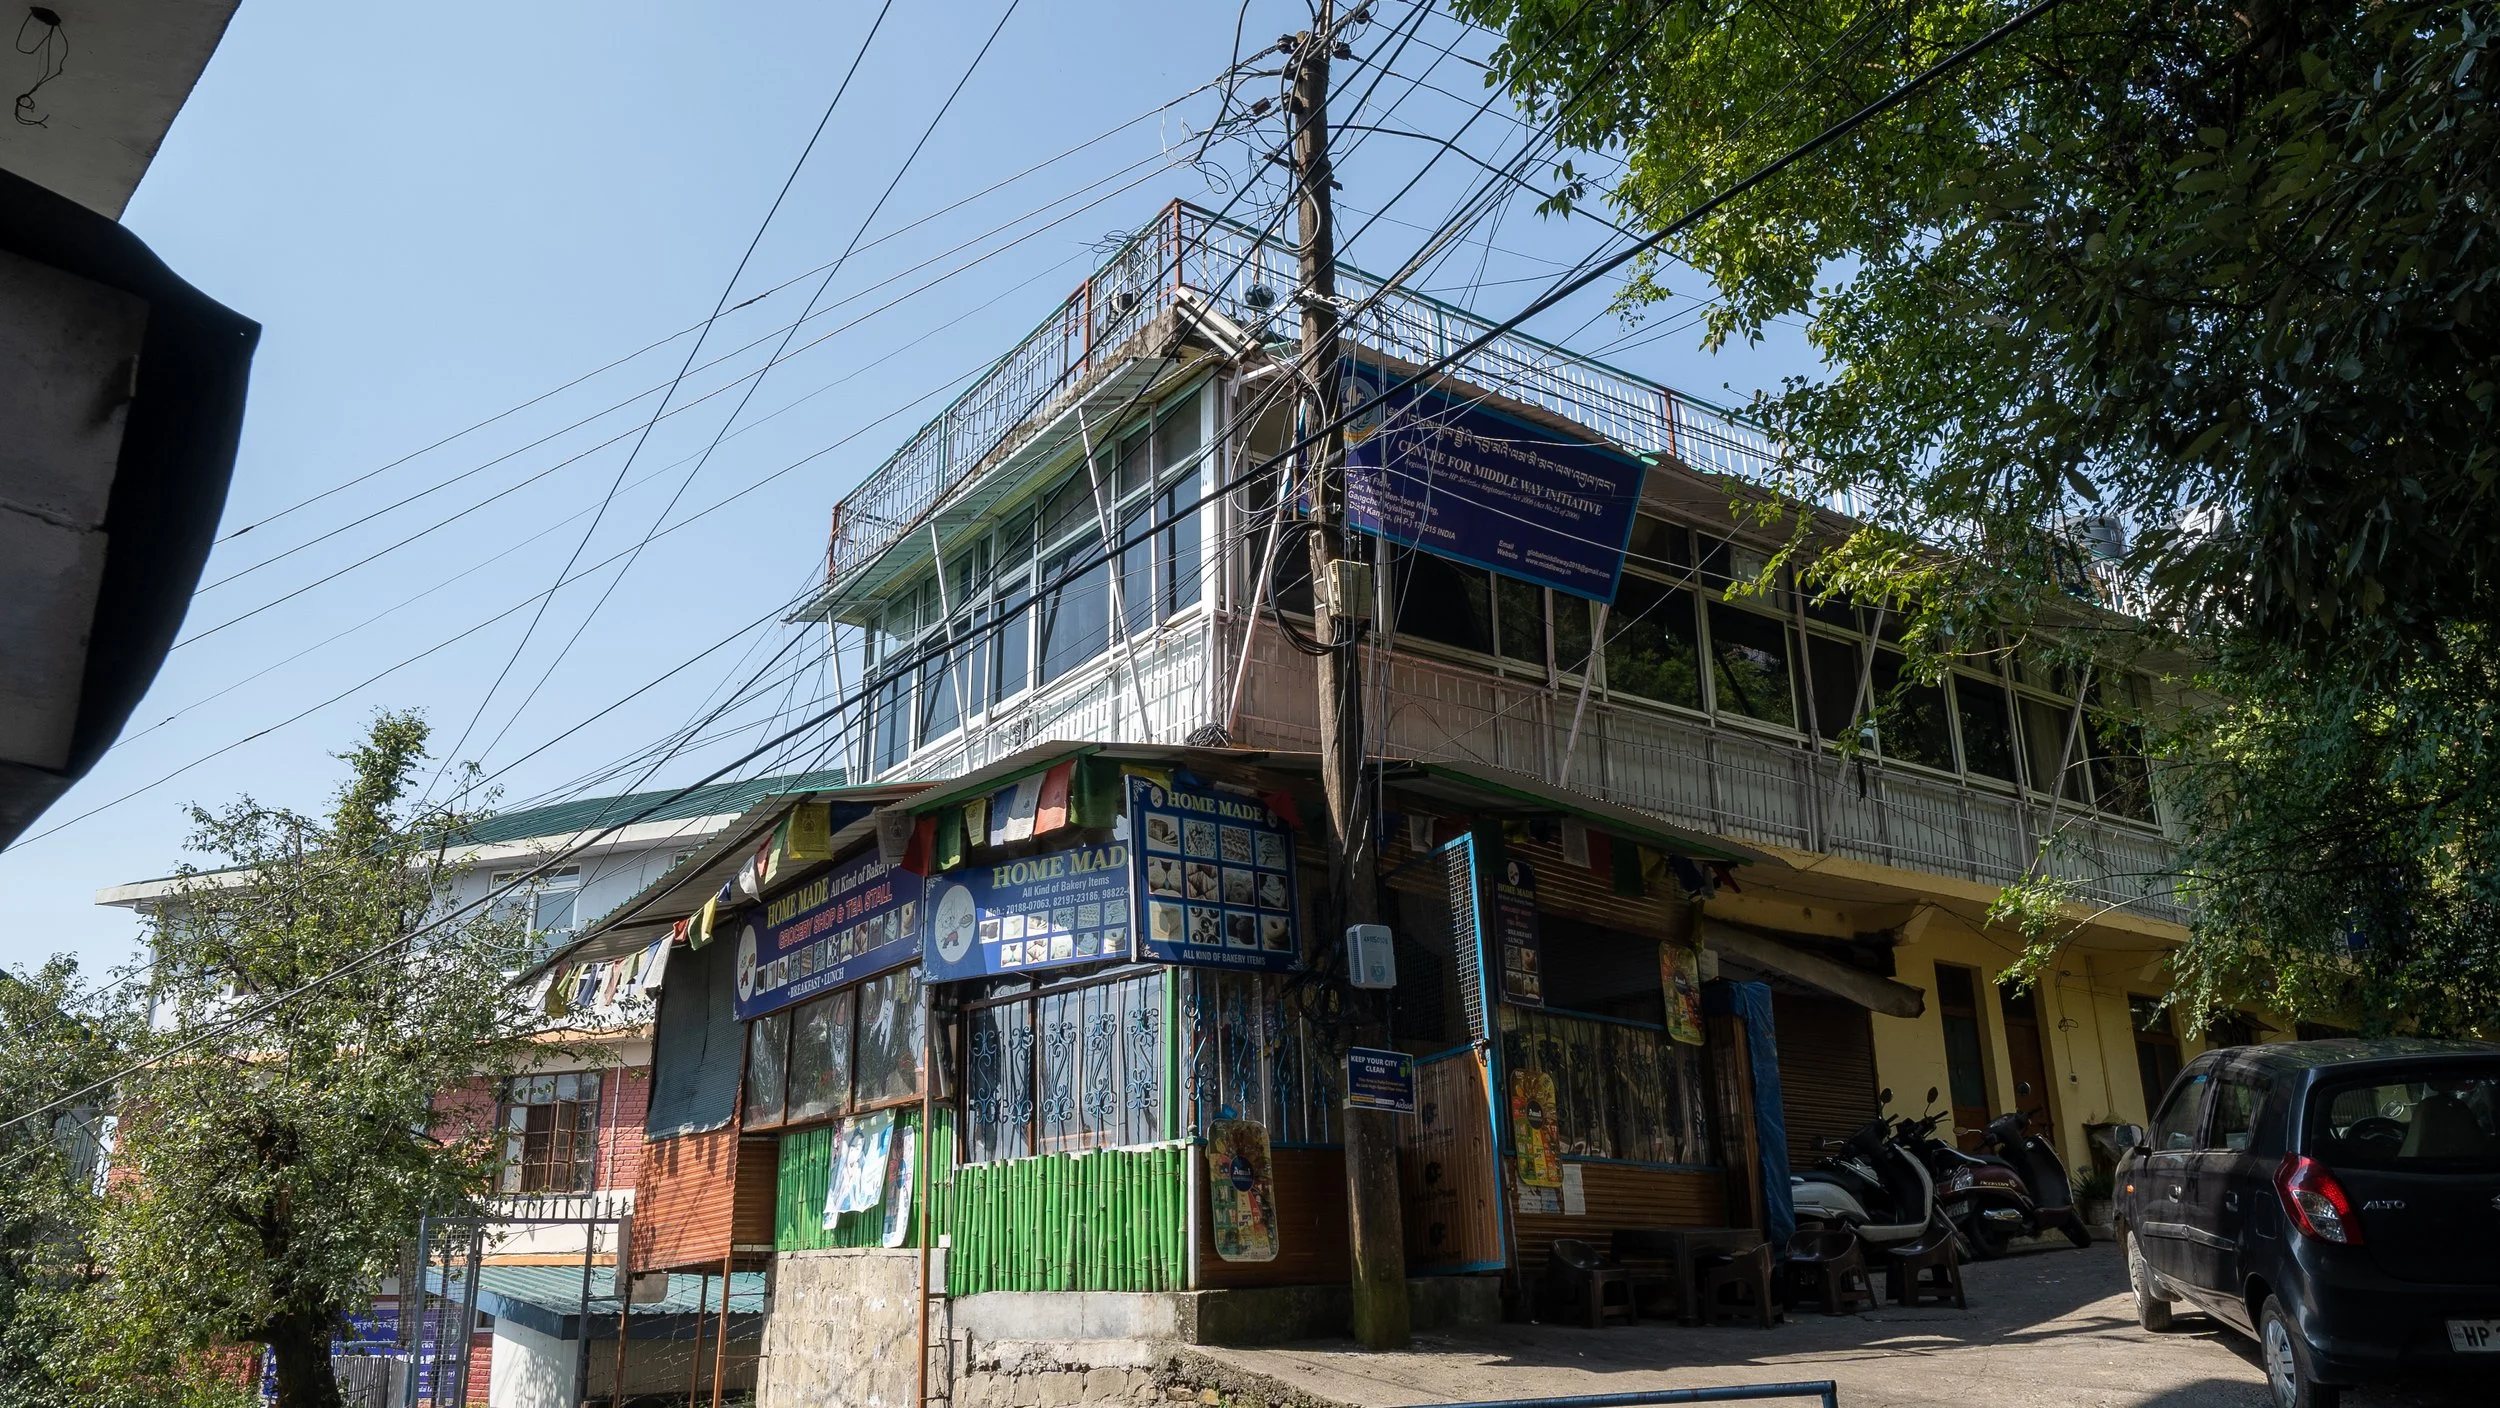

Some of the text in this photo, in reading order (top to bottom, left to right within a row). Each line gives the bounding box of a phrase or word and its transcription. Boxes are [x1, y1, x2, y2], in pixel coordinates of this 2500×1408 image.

[1404, 458, 1432, 473] Register
[1398, 439, 1603, 517] CENTRE FOR MIDDLE WAY INITIATIVE
[1348, 490, 1416, 520] Gangche Kyishong
[1416, 501, 1439, 517] Khng,
[1366, 506, 1393, 521] Kanra,
[1414, 521, 1437, 534] 17215
[1437, 528, 1456, 541] INDIA
[1496, 547, 1519, 560] Website
[1498, 539, 1515, 550] Email
[1167, 792, 1263, 821] HOME MADE
[992, 845, 1129, 890] HOME MAD
[1022, 875, 1110, 899] All Kind of Bakery Items
[1497, 882, 1516, 895] HOME
[767, 895, 797, 930] HOME
[797, 877, 829, 915] MADE
[830, 881, 840, 898] All
[840, 869, 857, 893] Kind
[857, 867, 867, 884] of
[1006, 899, 1051, 915] 70188-07063,
[1052, 893, 1101, 907] 82197-23186,
[778, 881, 893, 950] GROCERY SHOP & TEA STALL
[1183, 949, 1266, 966] ALL KIND OF BAKERY ITEMS
[790, 966, 845, 999] BREAKFAST LUNCH
[1350, 1055, 1398, 1068] KEEP YOUR CITY
[1365, 1065, 1385, 1074] CLEAN
[2362, 1200, 2406, 1211] ALTO
[2463, 1326, 2490, 1347] HP
